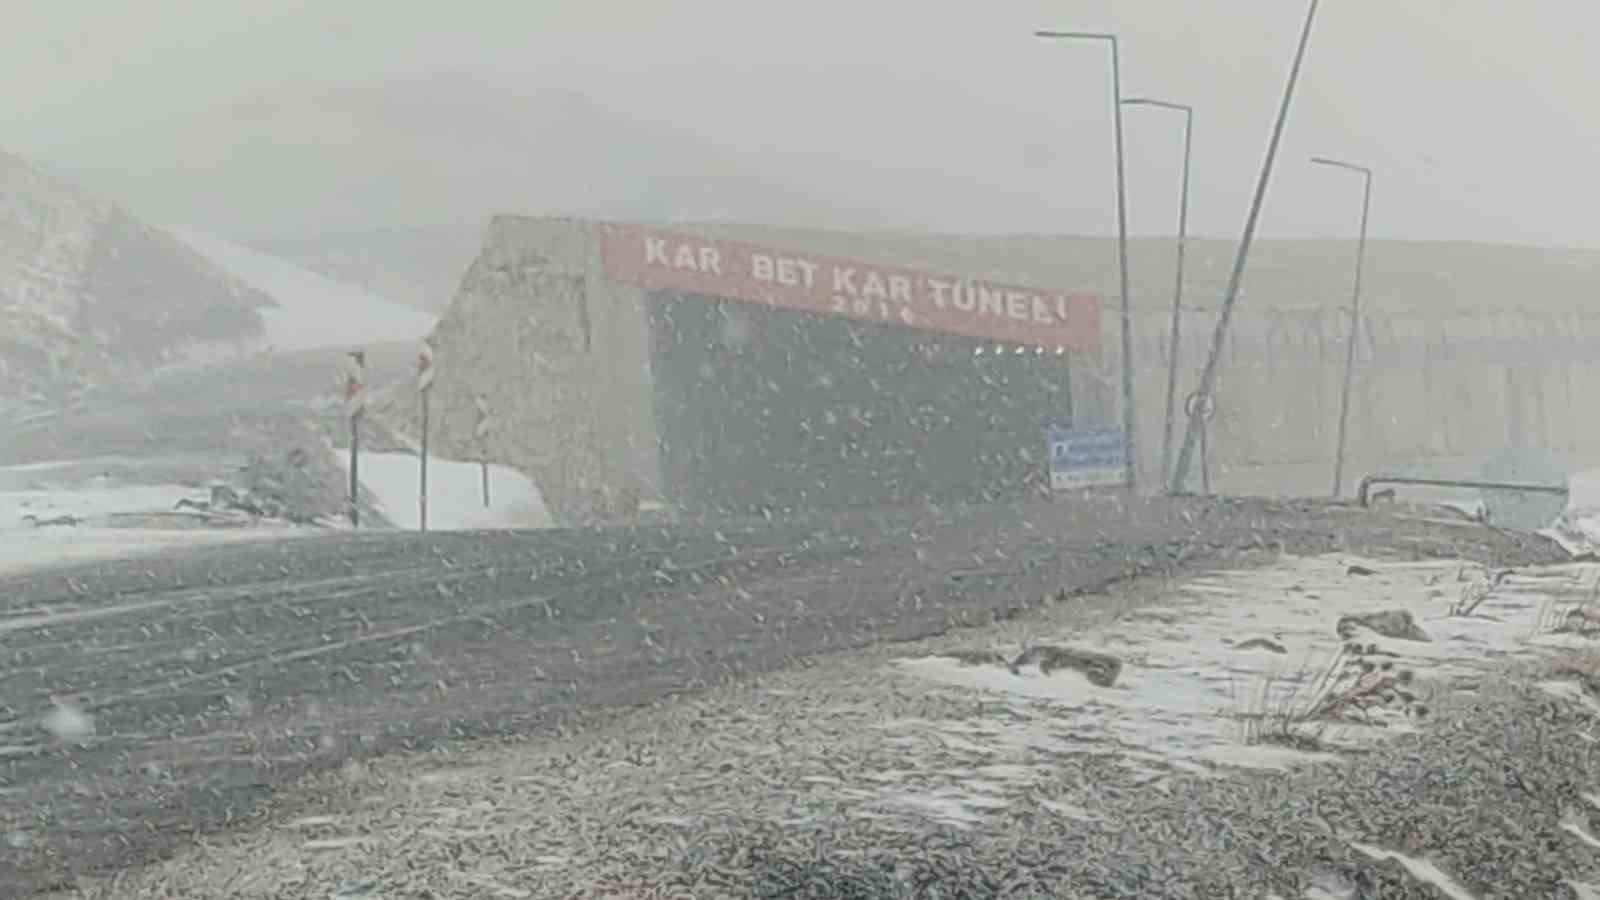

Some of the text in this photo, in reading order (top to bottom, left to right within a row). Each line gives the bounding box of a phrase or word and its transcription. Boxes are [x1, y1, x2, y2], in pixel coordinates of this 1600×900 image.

[644, 236, 721, 276] KAR
[751, 252, 819, 288] BET
[833, 265, 912, 303] KAR
